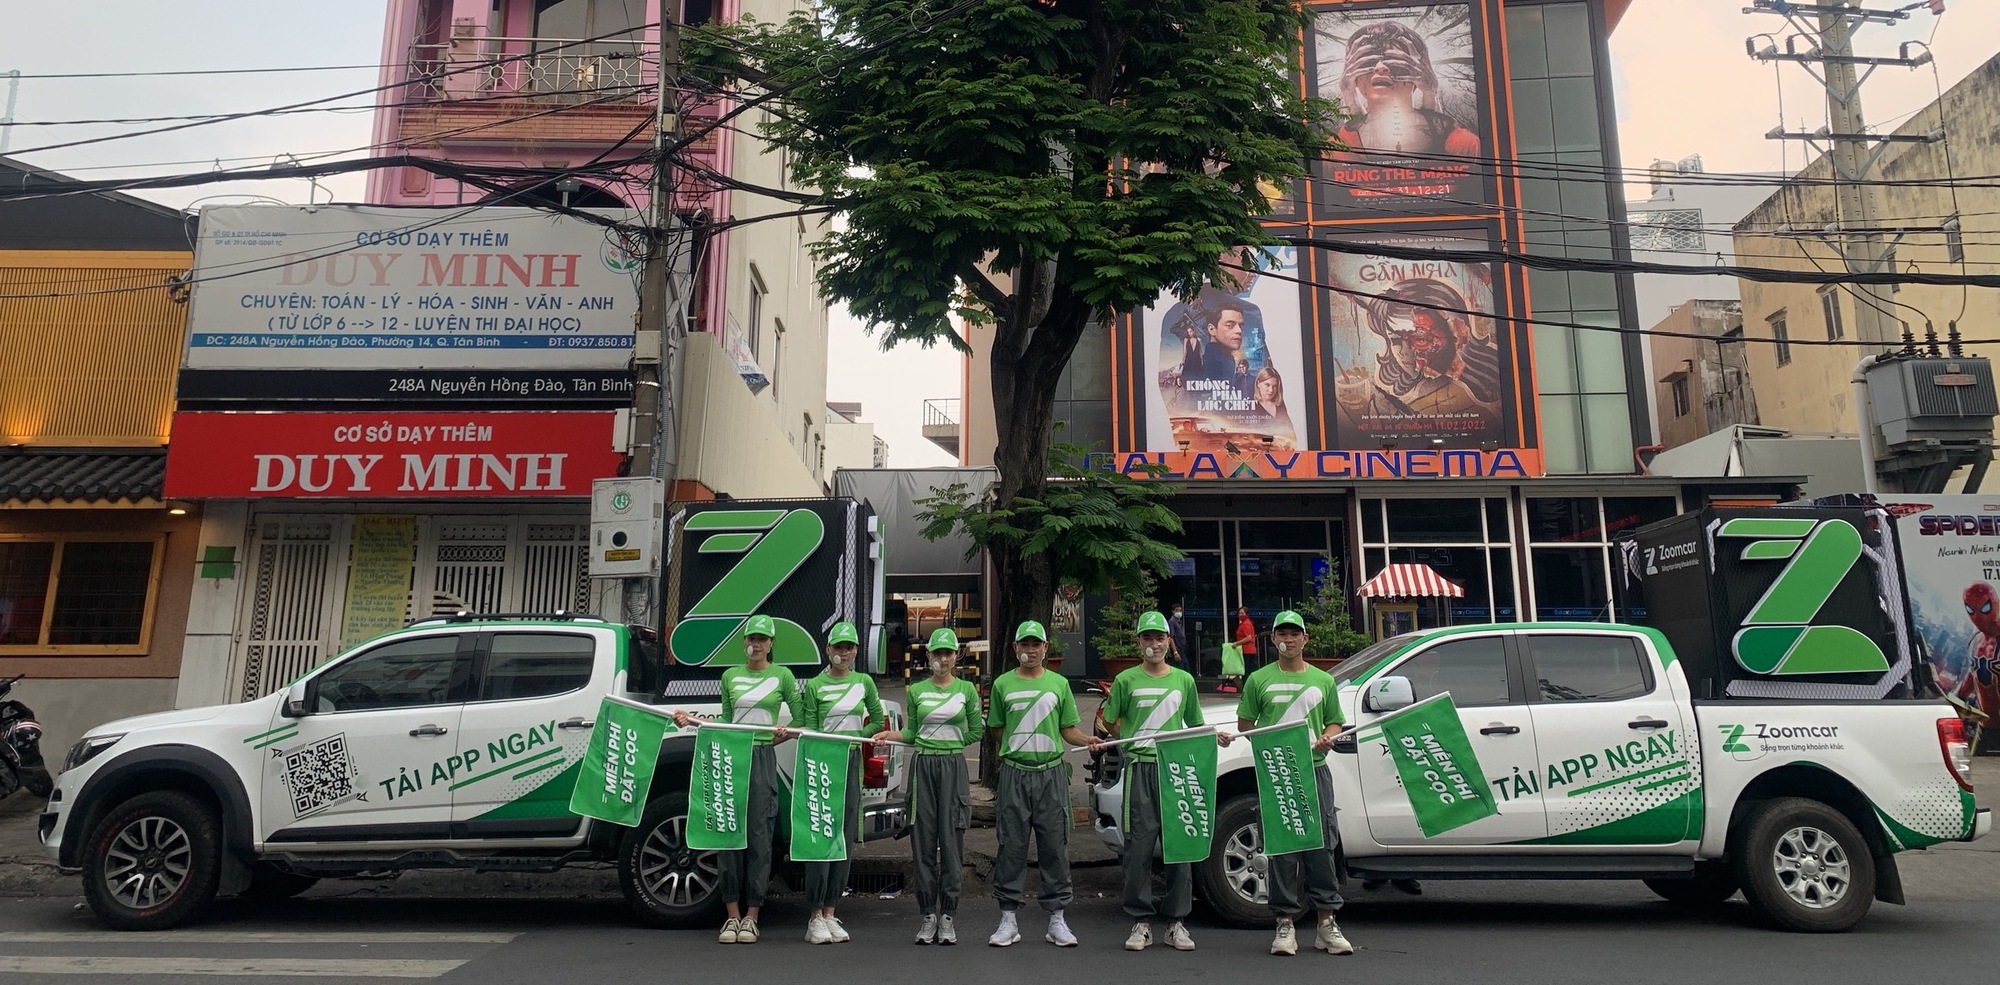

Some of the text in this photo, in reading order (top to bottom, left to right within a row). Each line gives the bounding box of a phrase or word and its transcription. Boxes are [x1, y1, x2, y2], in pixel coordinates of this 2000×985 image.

[1334, 168, 1380, 183] RỪNG
[357, 228, 508, 248] CƠ SỞ DẠY THÊM
[277, 252, 582, 288] DUY MINH
[241, 292, 614, 310] CHUYÊN: TOÁN LÝ HÓA SINH VĂN ANH
[303, 312, 332, 330] LỚP
[382, 316, 398, 330] 12
[415, 314, 470, 333] LUYỆN
[476, 317, 498, 330] THI
[504, 318, 532, 333] ĐẠI
[206, 336, 227, 345] ĐC:
[230, 336, 257, 345] 248A
[261, 334, 305, 347] Nguyễn
[308, 335, 338, 348] Hồng
[371, 337, 414, 348] Phường
[436, 338, 449, 347] Q.
[453, 338, 473, 346] Tân
[476, 337, 500, 346] Bình
[549, 338, 565, 346] ĐT:
[568, 338, 633, 346] 0937.850.81
[388, 376, 632, 395] 248A Nguyễn Hồng Đào, Tân Bình
[1186, 378, 1229, 391] KHÔNG
[1212, 386, 1242, 400] PHẢI
[1197, 397, 1258, 411] LÚC CHẾT
[334, 420, 492, 445] CƠ SỞ DẠY THÊM
[250, 453, 568, 492] DUY MINH
[1084, 451, 1527, 479] GALAXY CINEMA
[1659, 541, 1697, 560] Zoomcar
[1755, 724, 1838, 738] Zoomcar
[379, 720, 556, 800] TẢI APP NGAY
[603, 720, 622, 794] MIỄN PHÍ
[619, 729, 639, 804] ĐẶT CỌC
[1262, 749, 1279, 783] CHÌA
[1400, 734, 1455, 804] ĐẶT CỌC
[1420, 733, 1480, 800] MIỄN PHÍ
[1492, 729, 1676, 801] TẢI APP NGAY
[712, 741, 725, 833] KHÔNG CARE
[805, 757, 819, 832] MIỄN PHÍ
[820, 762, 835, 838] ĐẶT CỌC
[1169, 762, 1198, 837] ĐẶT CỌC
[1185, 765, 1206, 807] MIỄN
[1274, 746, 1306, 836] KHÔNG CARE
[725, 798, 737, 832] CHÌA
